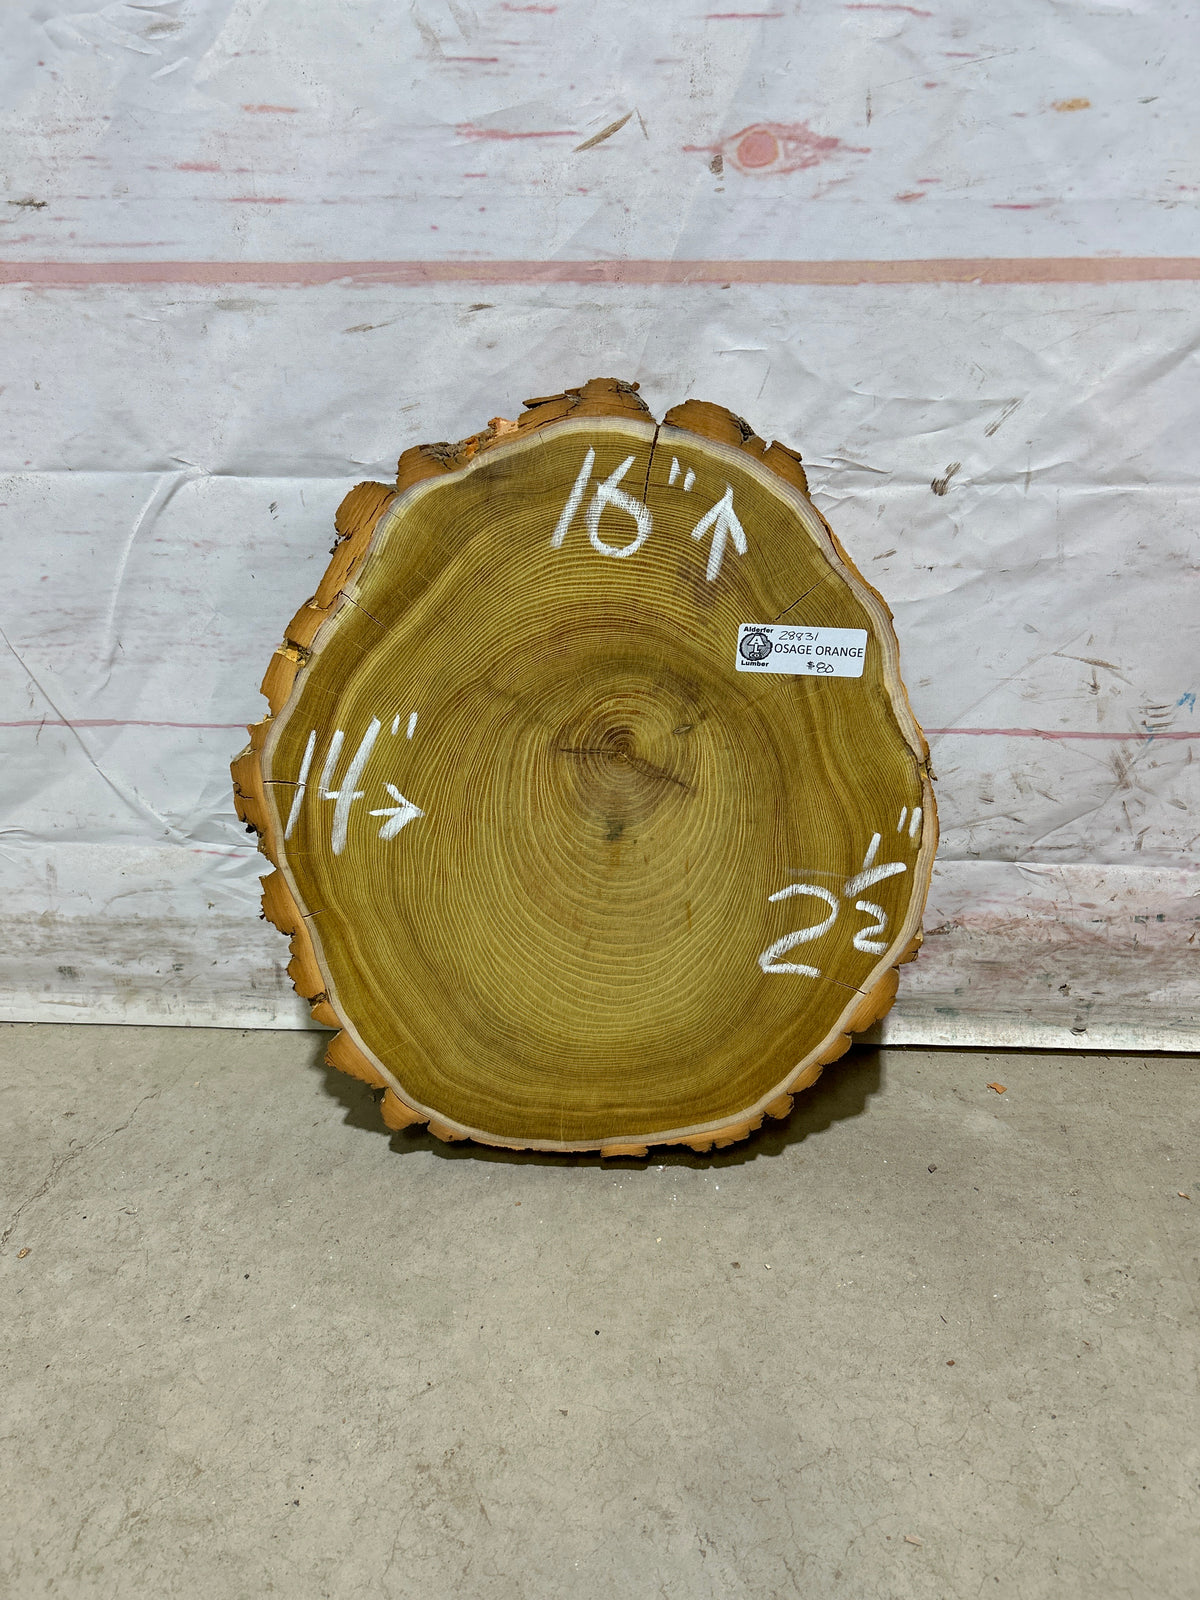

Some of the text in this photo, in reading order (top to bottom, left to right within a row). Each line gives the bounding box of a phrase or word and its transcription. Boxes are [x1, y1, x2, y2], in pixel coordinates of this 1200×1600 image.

[744, 626, 774, 634] Alderfer
[774, 643, 864, 658] OSAGE ORANGE
[806, 661, 834, 674] $80
